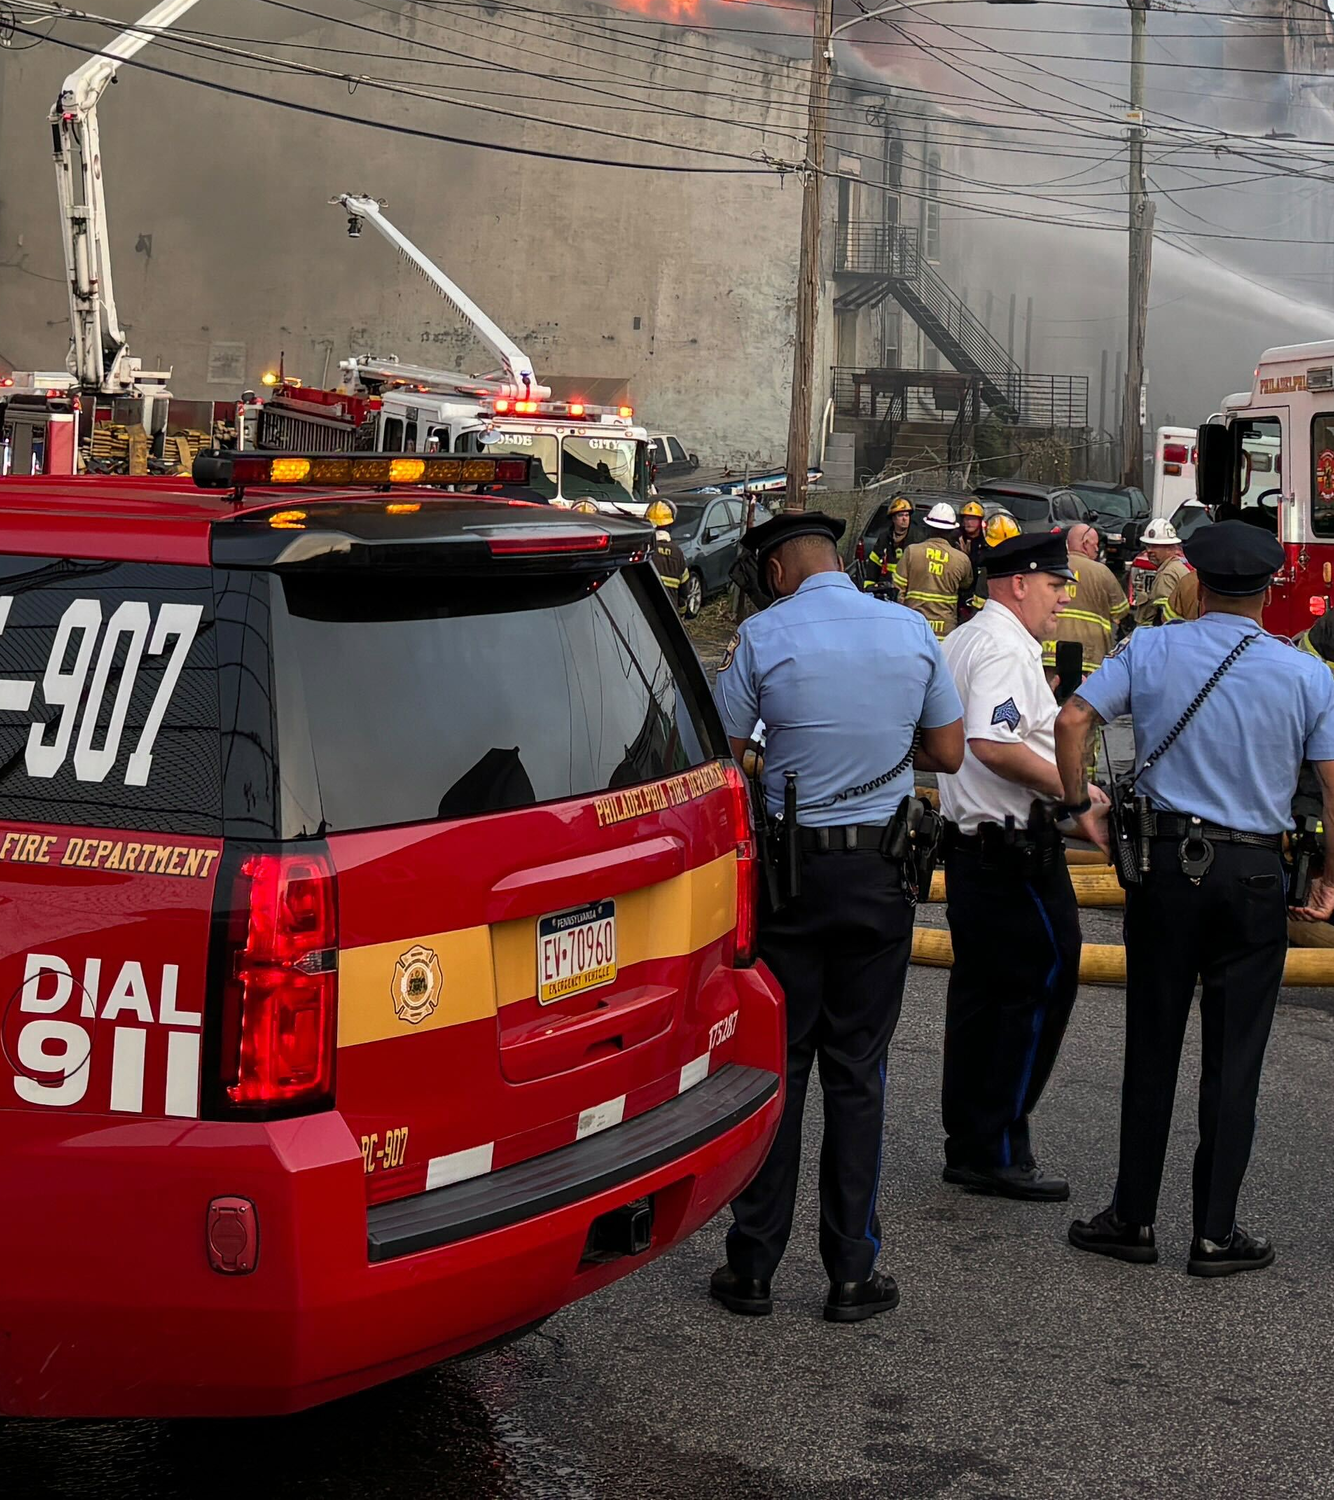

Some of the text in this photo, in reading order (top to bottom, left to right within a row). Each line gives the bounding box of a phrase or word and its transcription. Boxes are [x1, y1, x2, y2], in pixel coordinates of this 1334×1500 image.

[1260, 374, 1308, 395] PHILADELPHI
[496, 434, 620, 450] OLDE CITY
[926, 547, 949, 563] PHILA
[929, 620, 945, 632] OTT
[595, 782, 669, 827] PHILADELPHIA
[665, 776, 690, 807] FIRE
[61, 837, 220, 878] DEPARTMENT
[557, 909, 597, 929] PENNSYLVANIA
[20, 953, 202, 1027] DIAL
[549, 966, 611, 995] EMERGENCY VEHICLE
[709, 1009, 739, 1051] 175287
[13, 1019, 201, 1118] 911
